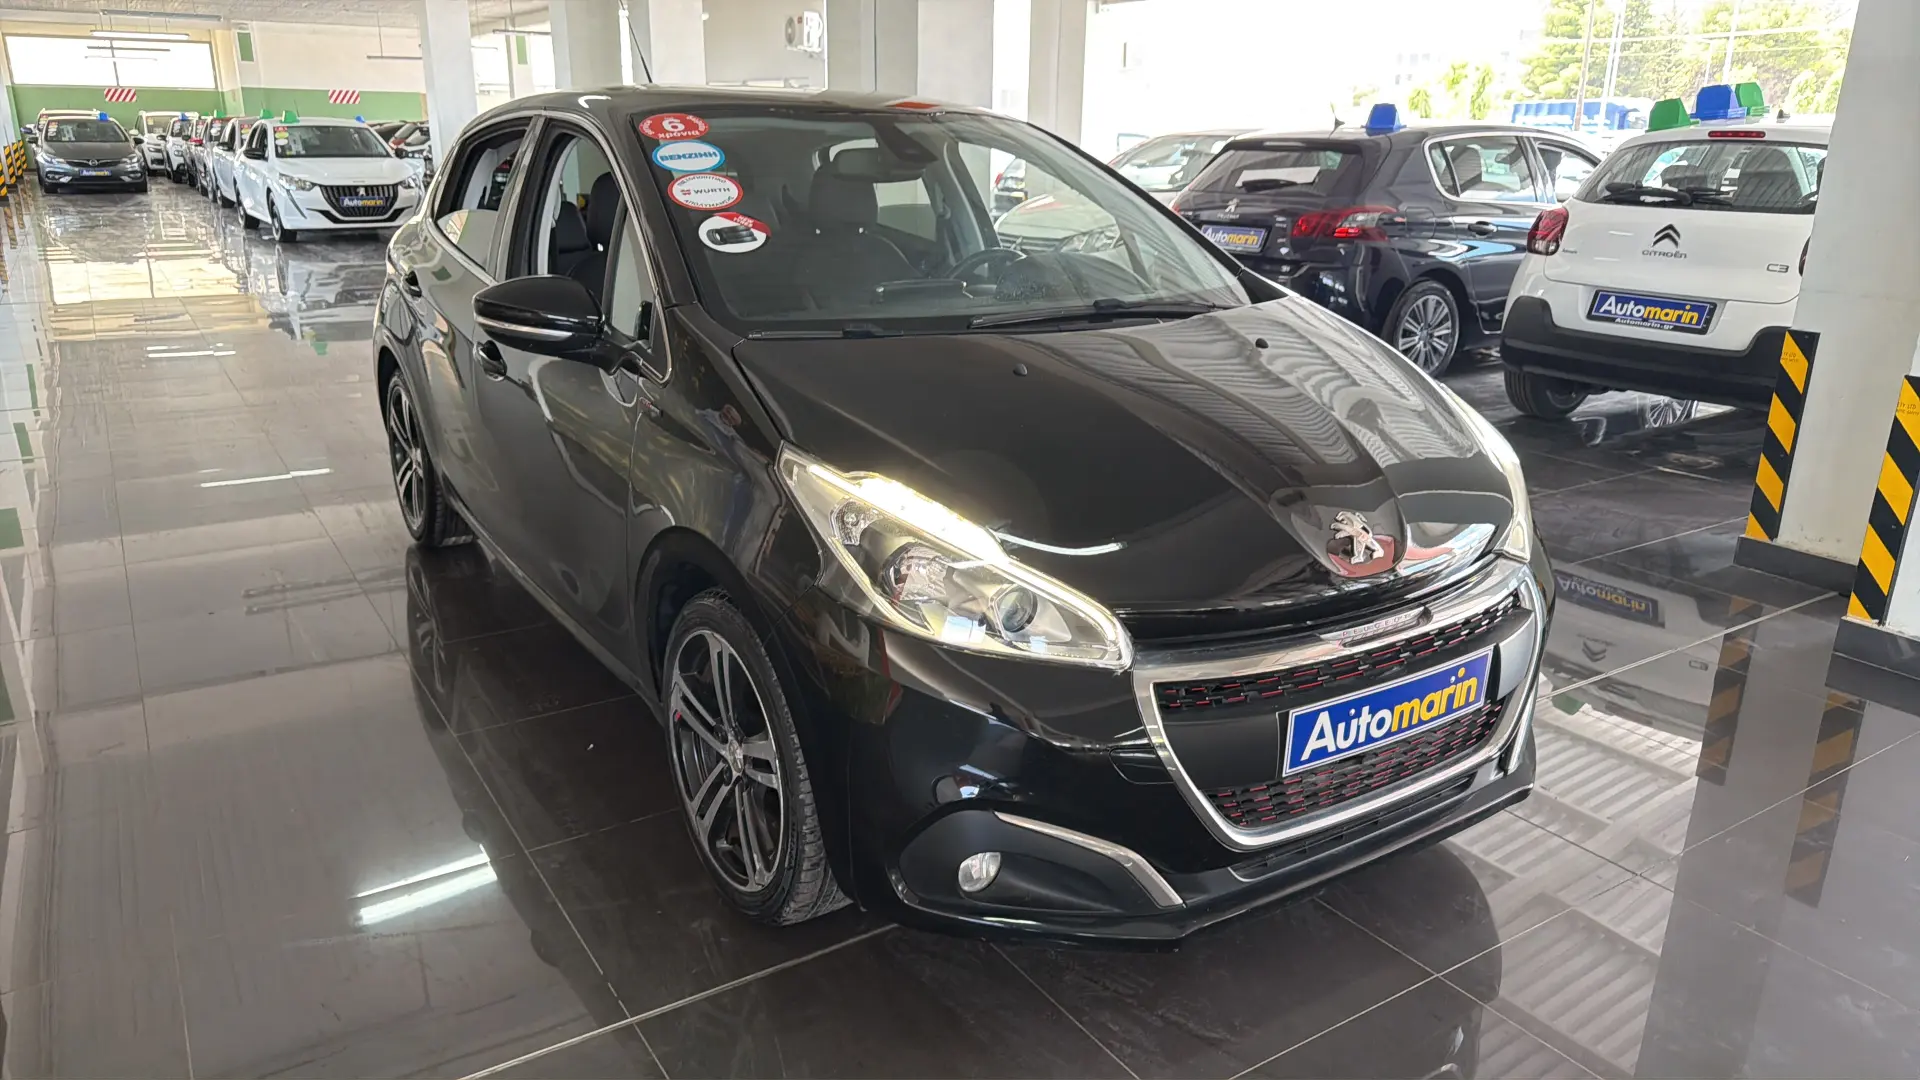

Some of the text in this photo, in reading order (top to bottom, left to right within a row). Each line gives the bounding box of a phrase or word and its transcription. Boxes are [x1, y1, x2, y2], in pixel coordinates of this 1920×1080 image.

[662, 118, 685, 132] 6
[343, 198, 383, 207] Automarin
[1204, 227, 1258, 246] Automarin
[1766, 263, 1790, 273] C3
[1600, 295, 1700, 325] Automarin
[1614, 317, 1674, 330] Automarin.gr
[1300, 667, 1478, 761] Automarin
